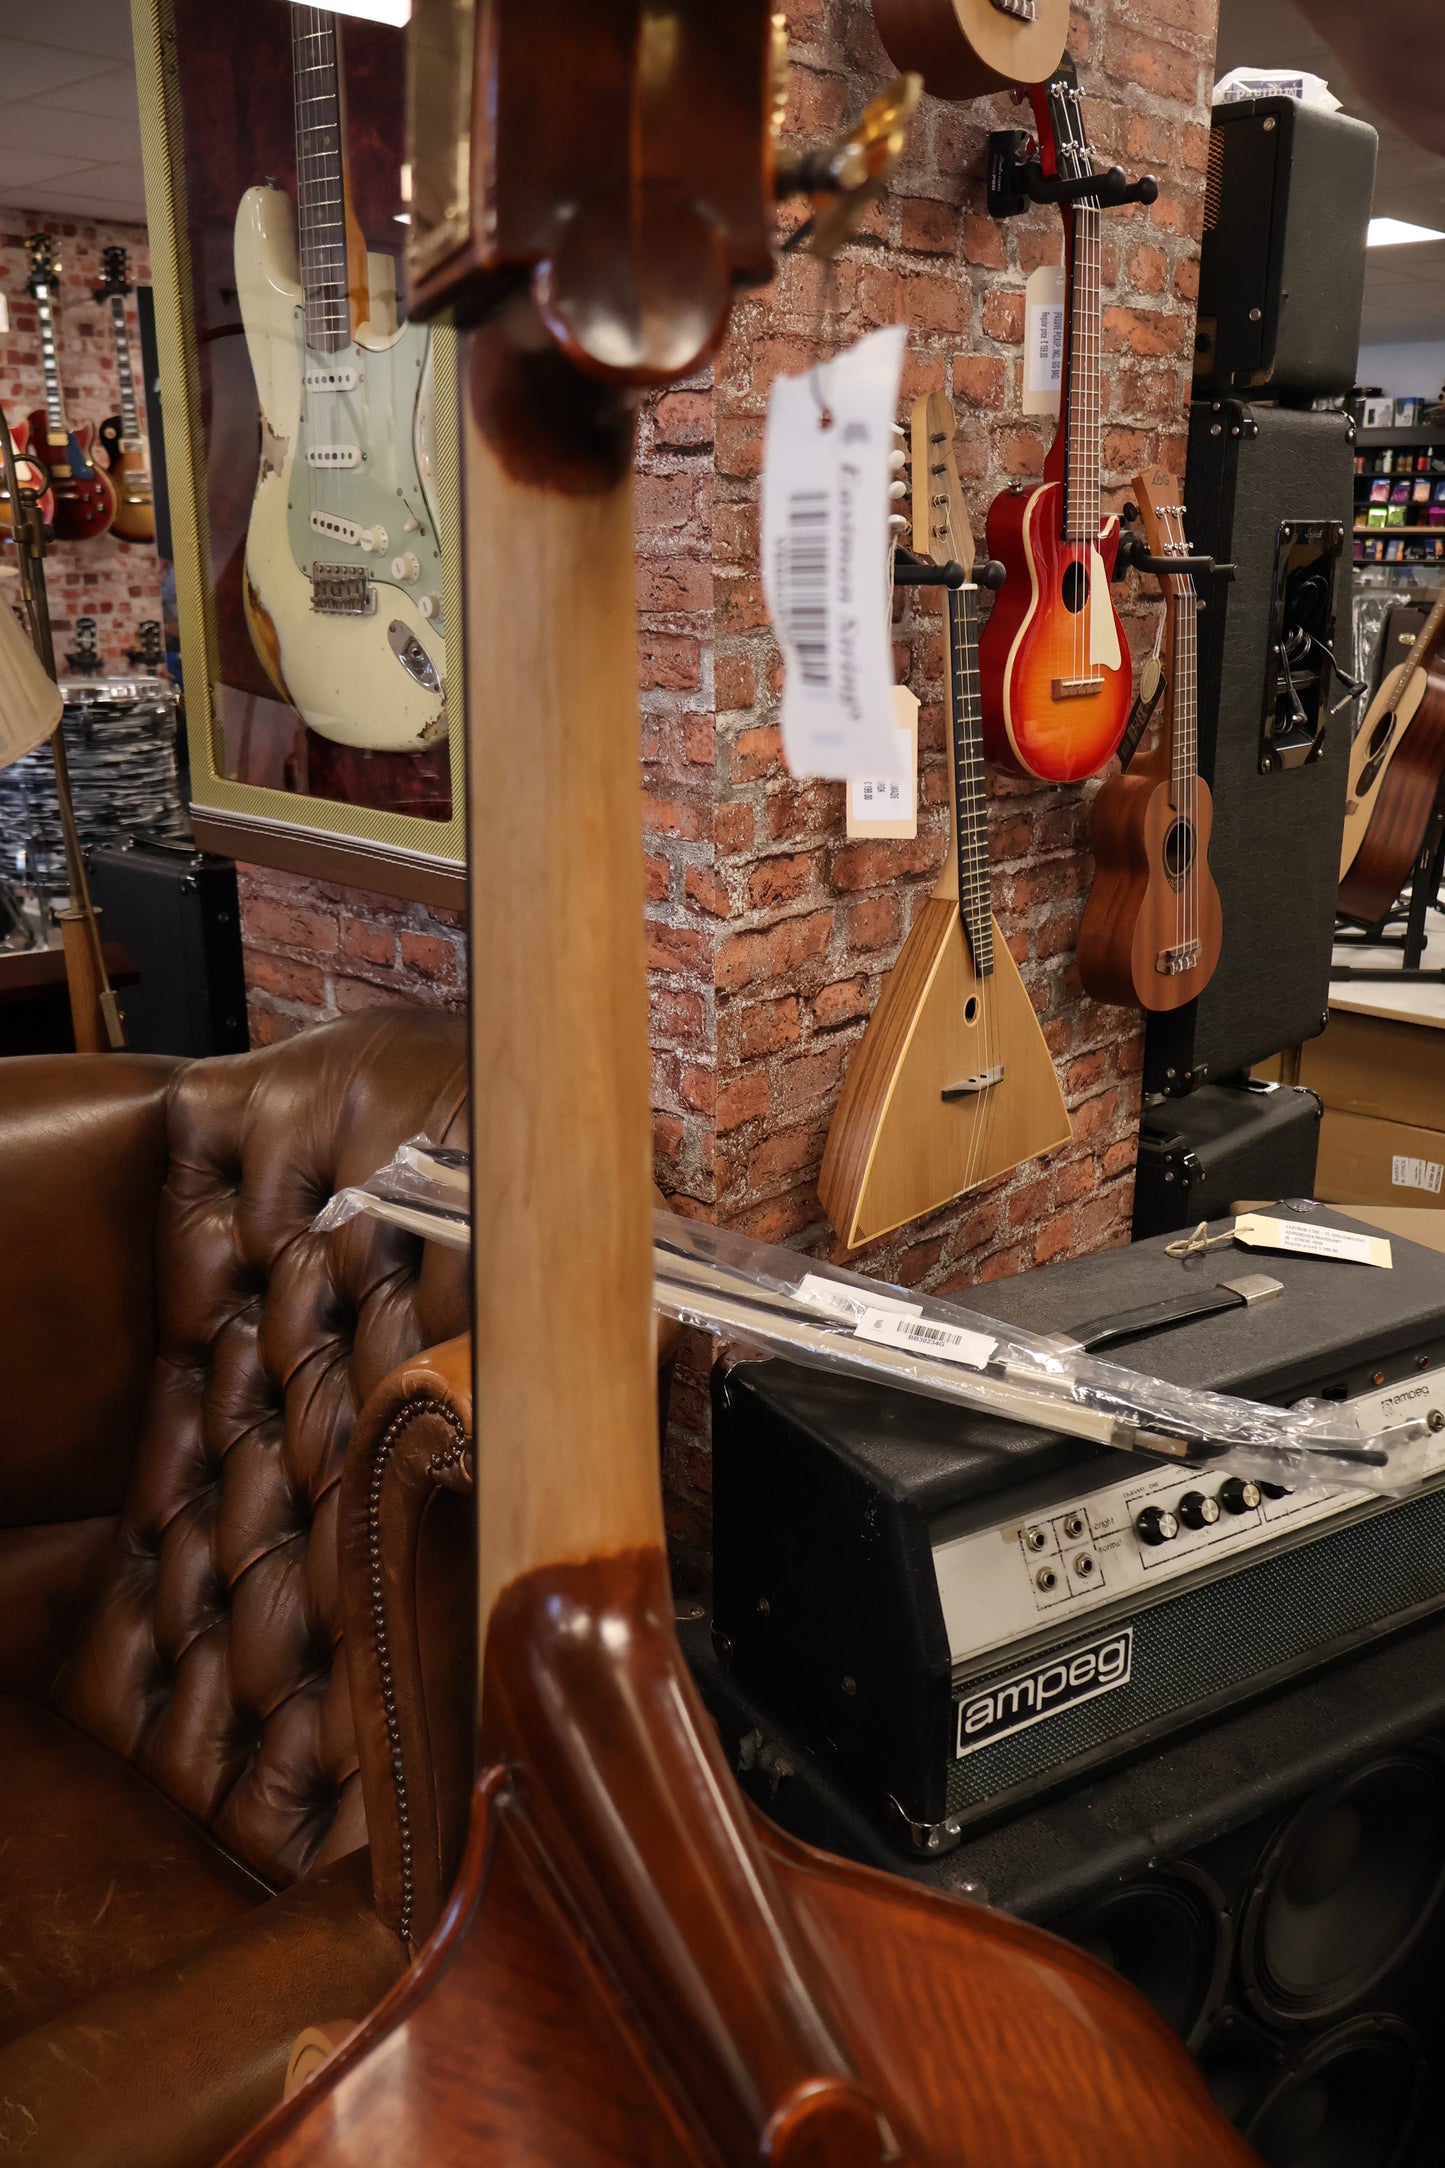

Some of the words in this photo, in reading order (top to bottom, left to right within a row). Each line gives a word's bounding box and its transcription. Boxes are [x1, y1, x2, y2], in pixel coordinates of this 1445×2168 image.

[1039, 311, 1050, 328] Regular
[1039, 328, 1048, 339] price
[1393, 1386, 1430, 1404] ampeg
[964, 1637, 1127, 1736] ampeg
